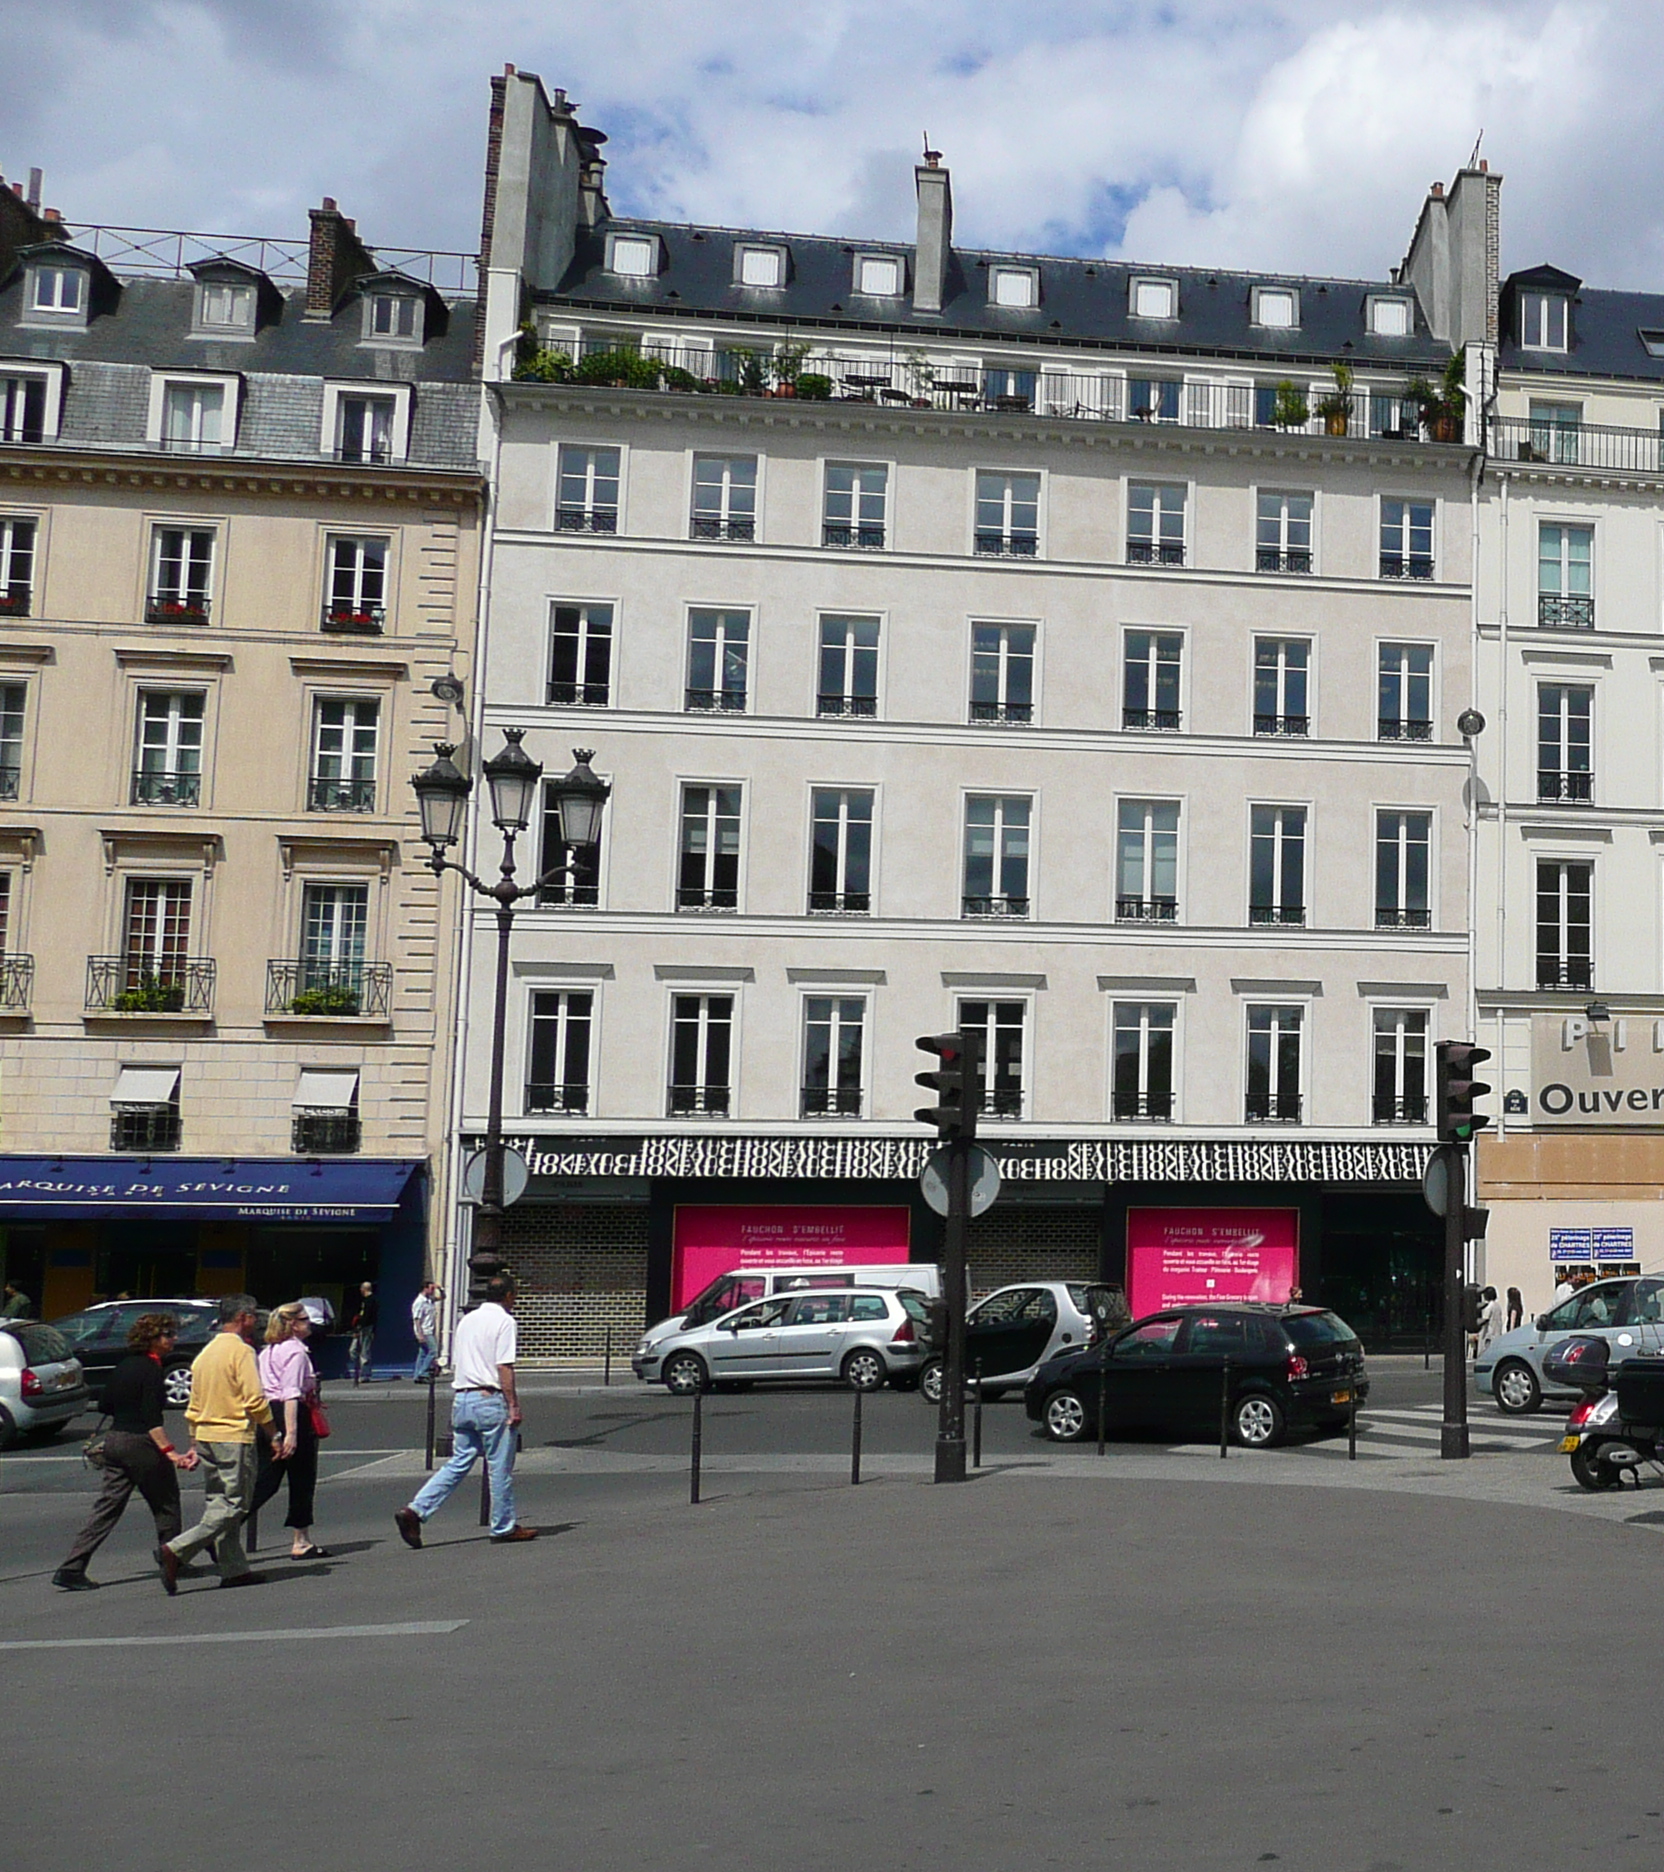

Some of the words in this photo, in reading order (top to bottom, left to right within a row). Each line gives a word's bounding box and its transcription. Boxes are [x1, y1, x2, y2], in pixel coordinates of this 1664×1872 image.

[128, 1183, 164, 1193] DE
[742, 1225, 784, 1234] FAUCHON
[1164, 1227, 1204, 1236] FAUCHON
